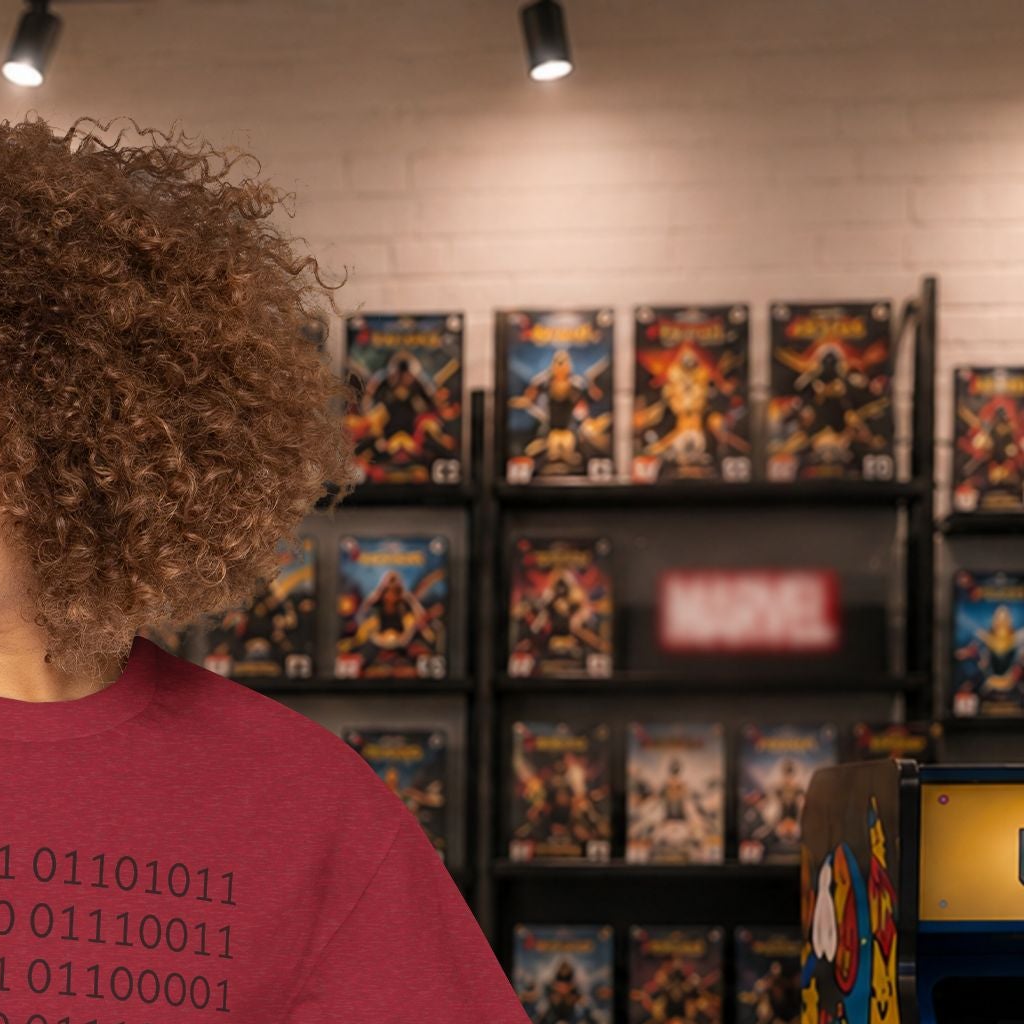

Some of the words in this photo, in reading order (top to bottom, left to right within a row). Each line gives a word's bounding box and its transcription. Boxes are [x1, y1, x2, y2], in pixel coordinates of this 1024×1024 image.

[33, 847, 235, 905] 01101011
[30, 903, 232, 959] 01110011
[28, 959, 229, 1012] 01100001
